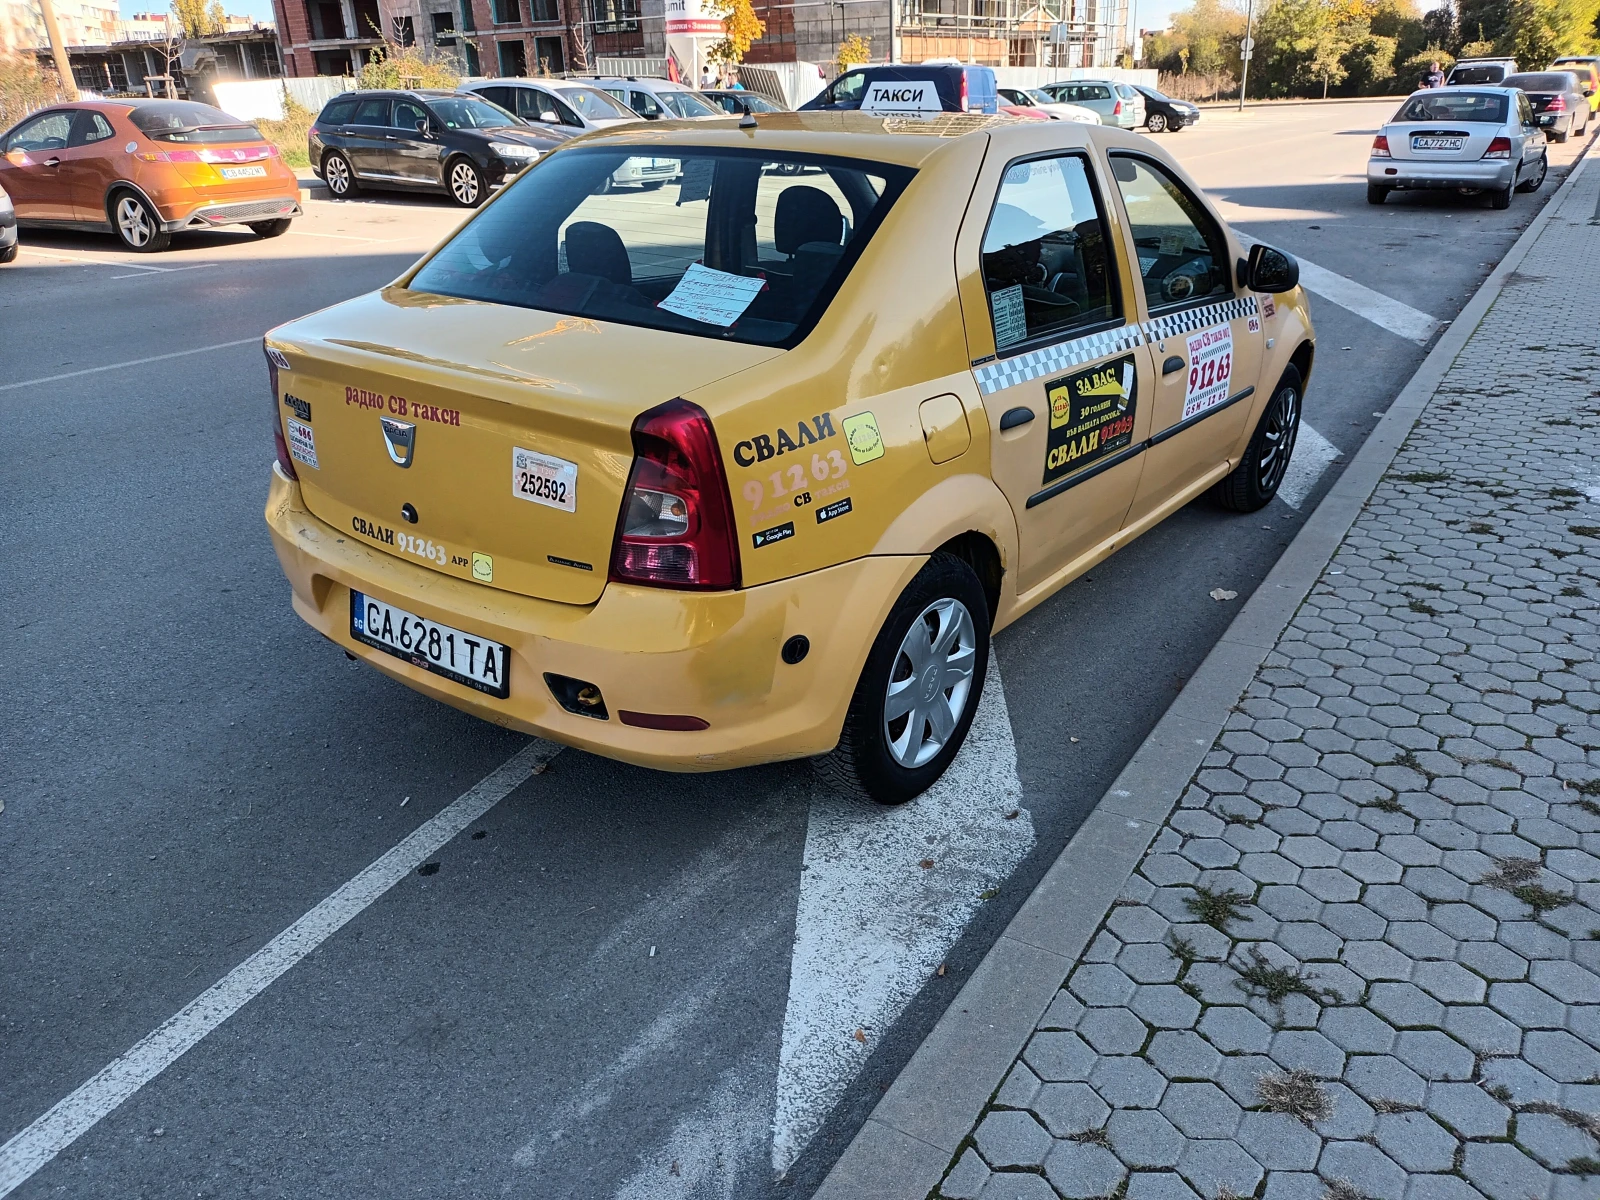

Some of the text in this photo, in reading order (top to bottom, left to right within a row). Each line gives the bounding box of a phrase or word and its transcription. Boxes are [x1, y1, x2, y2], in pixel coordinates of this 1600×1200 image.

[873, 89, 924, 102] ТАКСИ
[1248, 318, 1259, 331] 686
[1075, 367, 1116, 396] ЗА ВАС!
[345, 386, 461, 427] радио СВ такси
[1079, 405, 1091, 420] 30
[297, 425, 312, 441] 686
[384, 425, 408, 437] DACIA
[733, 412, 836, 468] СВАЛИ
[1047, 414, 1133, 470] СВАЛИ 91263
[520, 472, 566, 503] 252592
[793, 491, 812, 508] СВ
[837, 504, 850, 514] Store
[352, 516, 395, 546] СВАЛИ
[397, 532, 447, 566] 91263
[766, 531, 783, 542] Google
